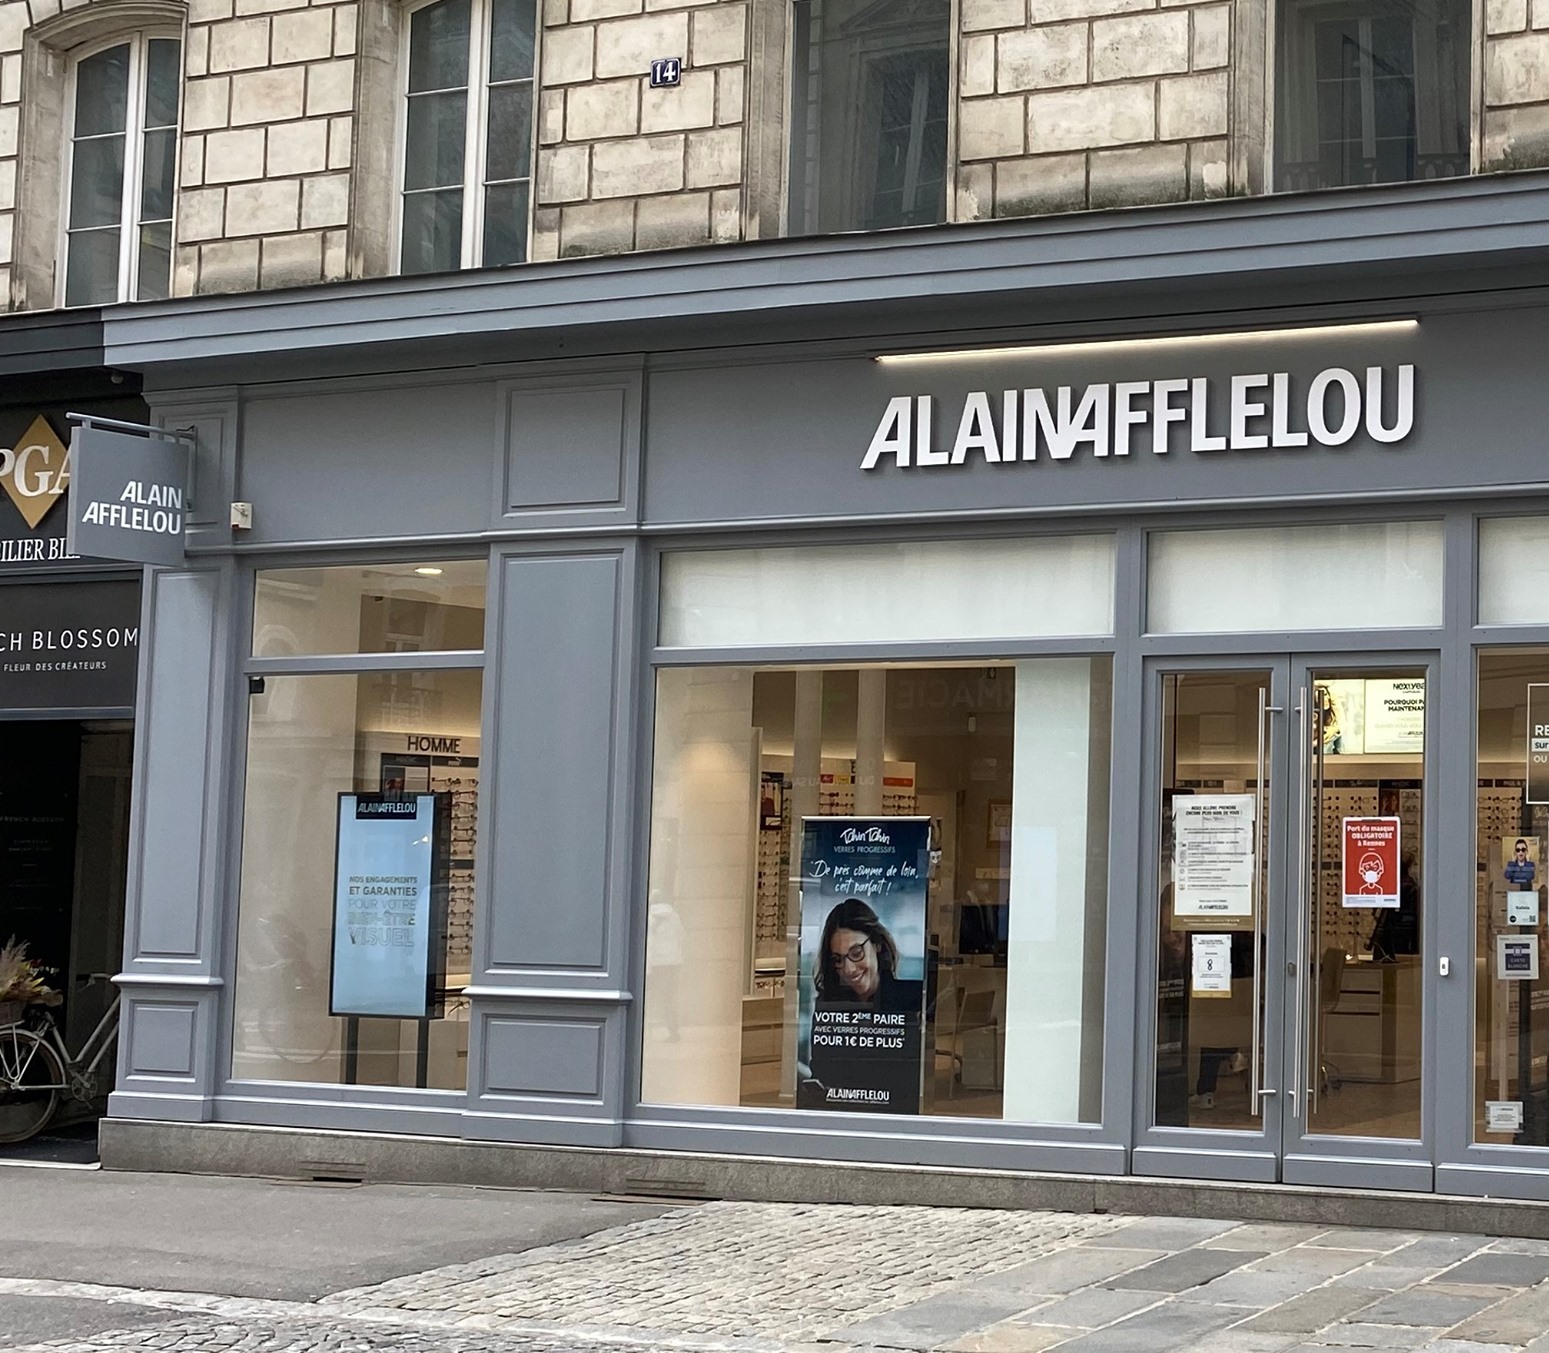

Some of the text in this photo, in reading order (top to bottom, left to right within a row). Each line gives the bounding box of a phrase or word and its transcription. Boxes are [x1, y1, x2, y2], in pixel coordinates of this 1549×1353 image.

[656, 61, 677, 83] 14
[120, 480, 182, 509] ALAIN
[81, 501, 181, 535] AFFLELOU
[48, 537, 80, 560] BI
[32, 627, 138, 650] BLOSSOM
[3, 660, 107, 672] FLEUR DES CRÉATEURS
[407, 736, 462, 754] HOMME
[1534, 741, 1549, 749] sur
[1533, 755, 1548, 763] OU
[857, 846, 896, 854] PROGRESSIFS
[833, 864, 850, 881] près
[853, 865, 883, 881] comme
[886, 864, 898, 877] de
[349, 875, 418, 884] NOS ENGAGEMENTS
[349, 886, 418, 896] ET GARANTIES
[834, 878, 854, 894] c'est
[853, 878, 887, 897] parfait
[1207, 958, 1213, 971] 8
[814, 1011, 850, 1023] VOTRE
[873, 1013, 906, 1025] PAIRE
[814, 1025, 905, 1036] AVEC VERRES PROGRESSIFS
[813, 1035, 843, 1046] POUR
[845, 1036, 858, 1047] 1€
[859, 1036, 874, 1047] DE
